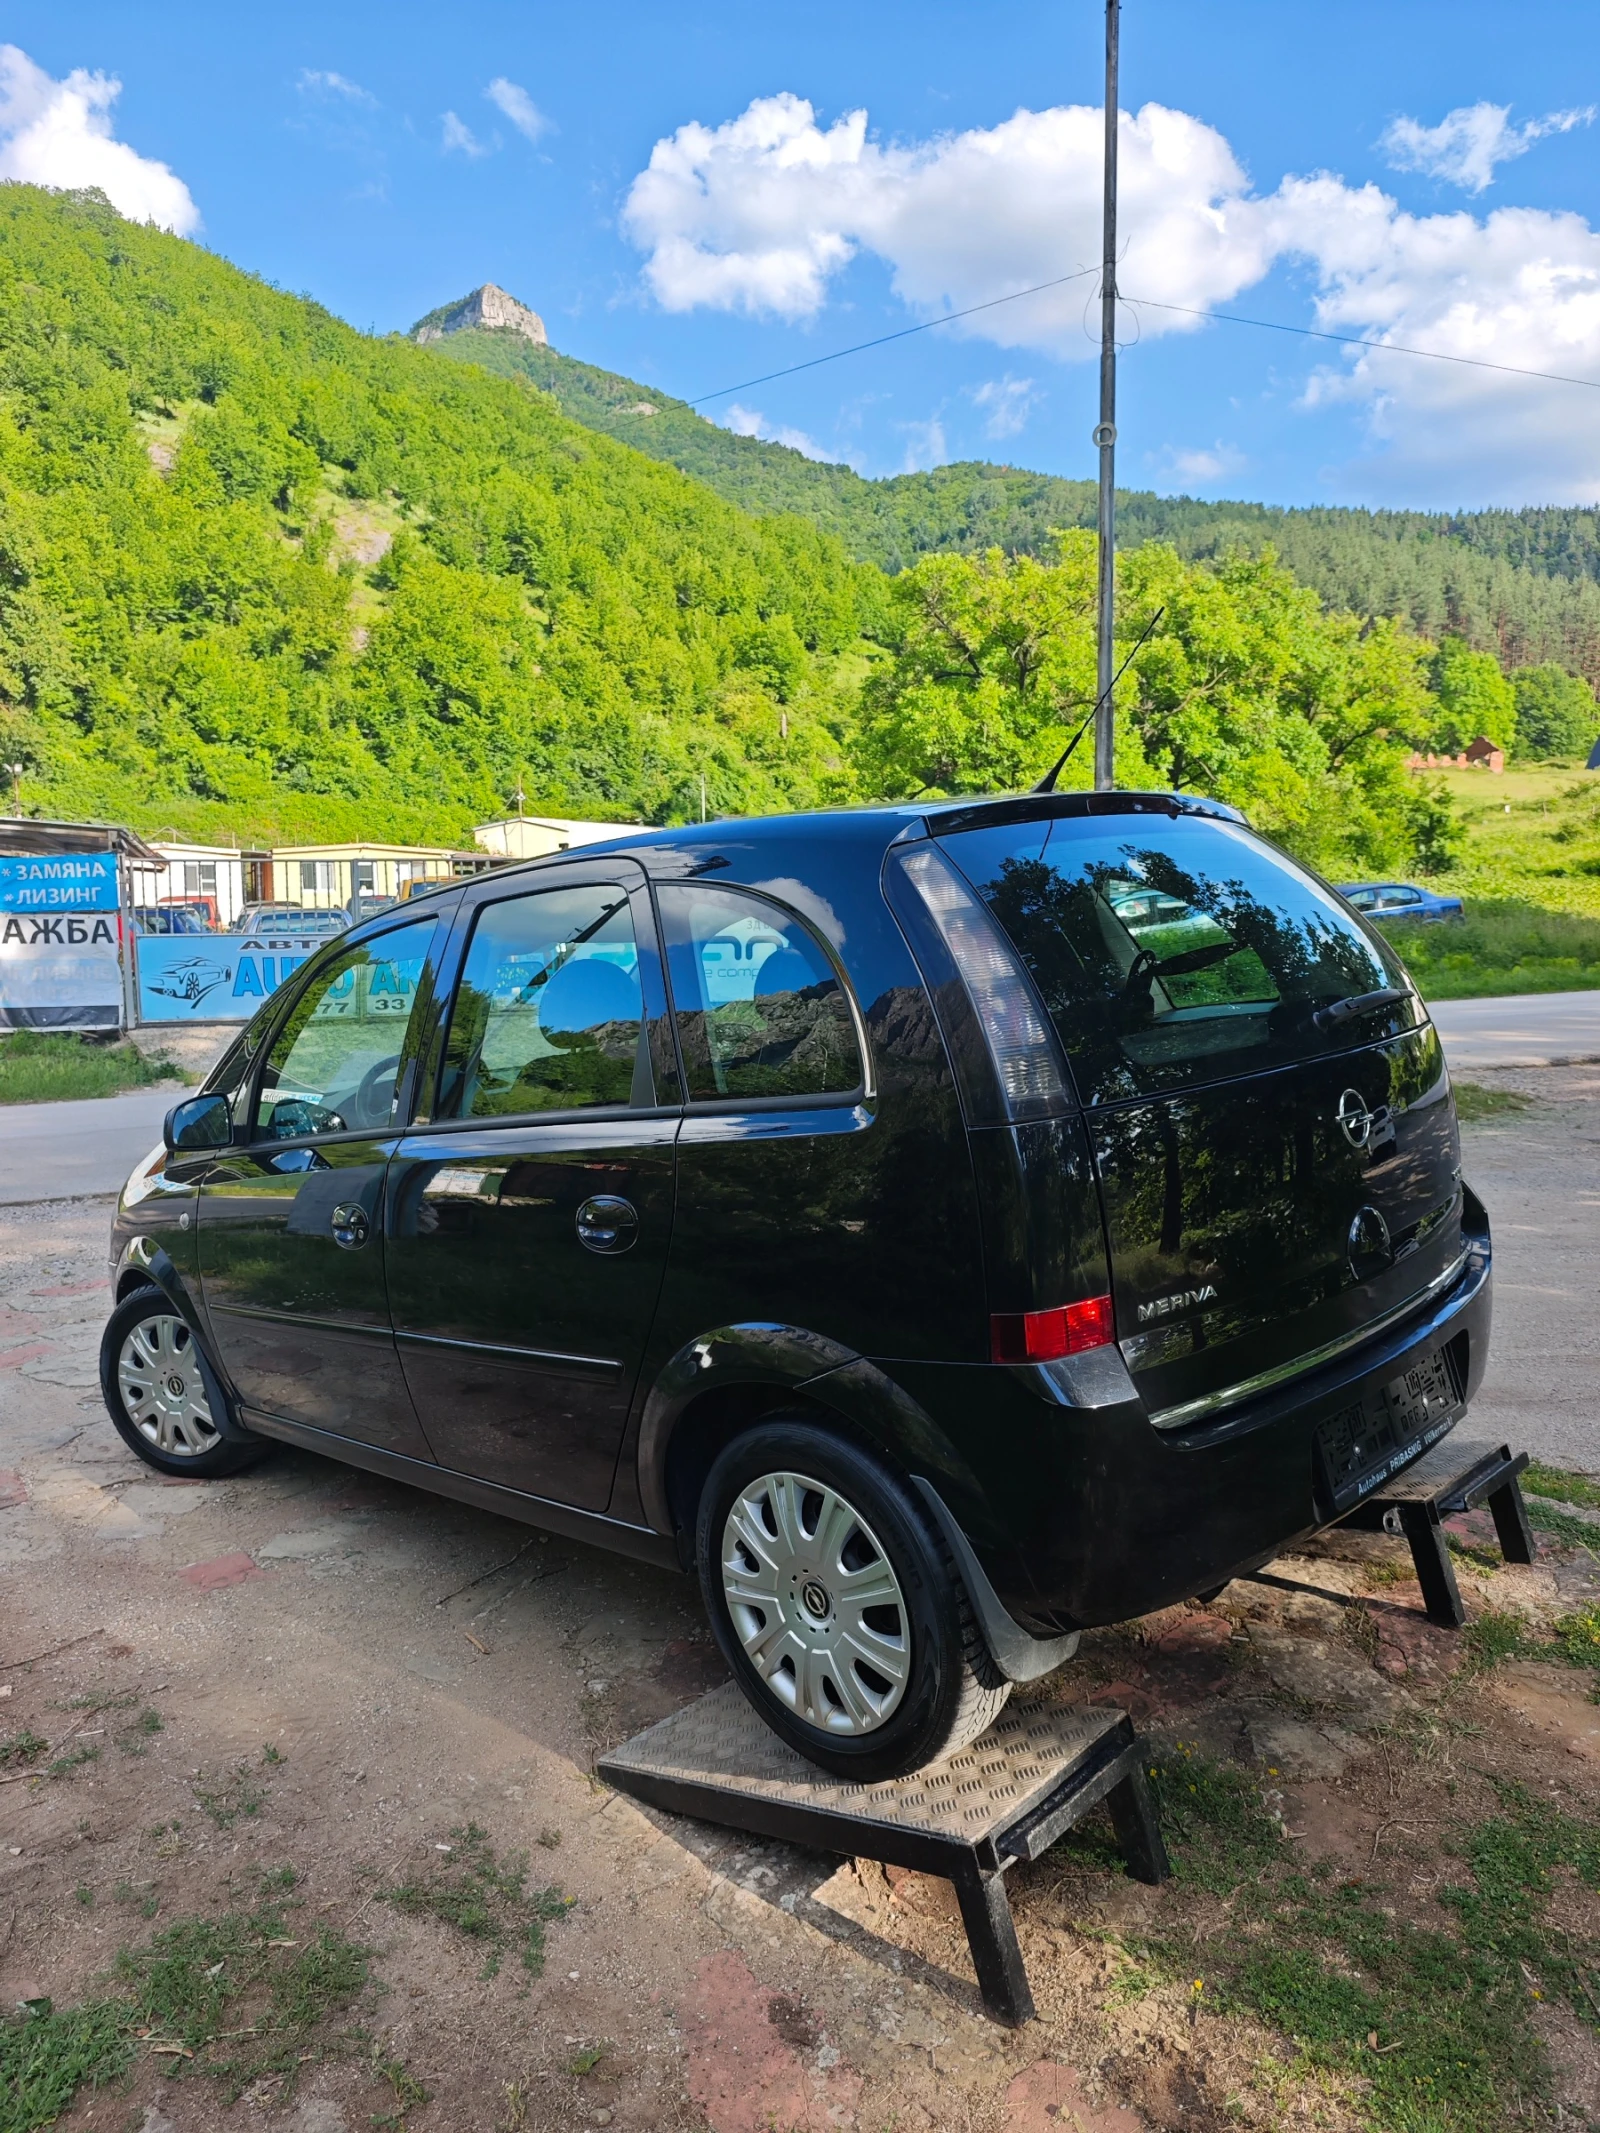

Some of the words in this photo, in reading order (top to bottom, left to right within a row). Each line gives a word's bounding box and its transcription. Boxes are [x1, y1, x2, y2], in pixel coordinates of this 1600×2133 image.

[16, 862, 106, 881] ЗАМЯНА
[16, 887, 102, 905] ЛИЗИНГ
[2, 918, 114, 944] АЖБА
[374, 998, 406, 1011] 33
[1137, 1284, 1218, 1322] MERIVA
[1358, 1468, 1388, 1497] Autohaus
